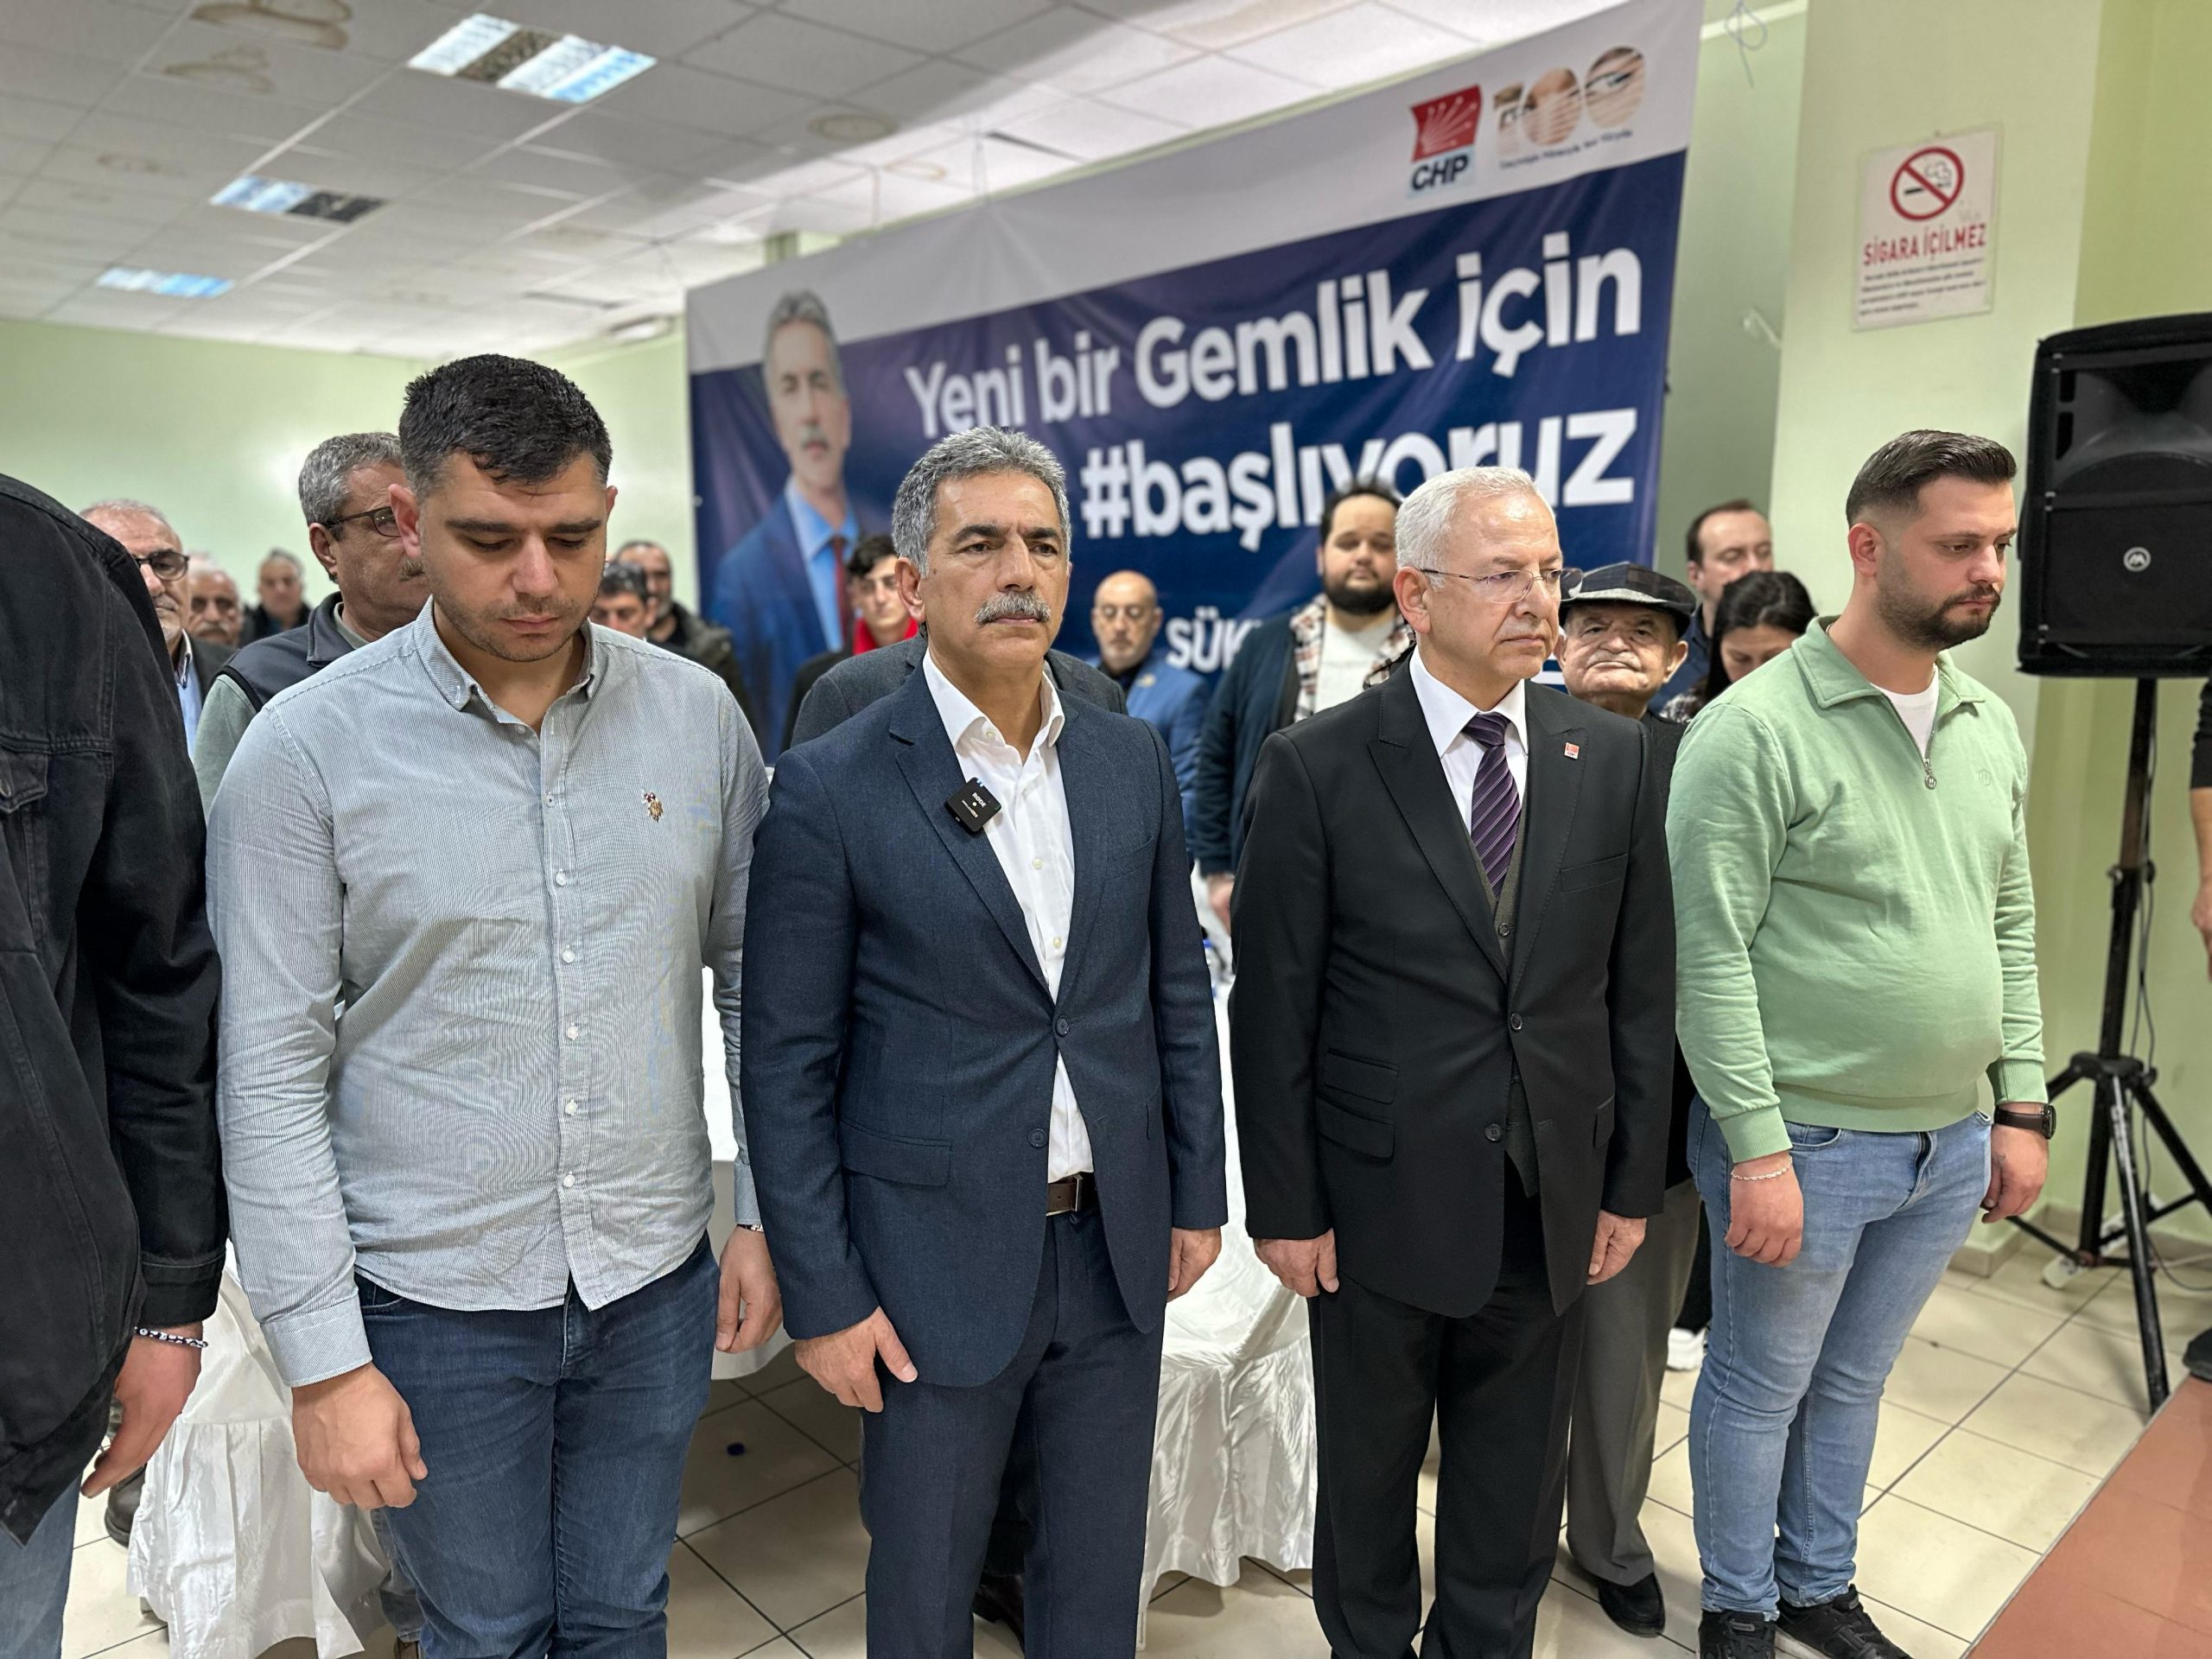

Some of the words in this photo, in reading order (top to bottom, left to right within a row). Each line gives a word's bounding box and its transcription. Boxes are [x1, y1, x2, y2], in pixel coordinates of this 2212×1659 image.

[1411, 154, 1470, 191] CHP
[1864, 234, 1919, 266] SİGARA
[1923, 222, 1986, 261] İÇİLMEZ
[905, 344, 1026, 439] Yeni
[1034, 331, 1120, 423] bir
[1135, 269, 1433, 408] Gemlik
[1456, 231, 1642, 378] için
